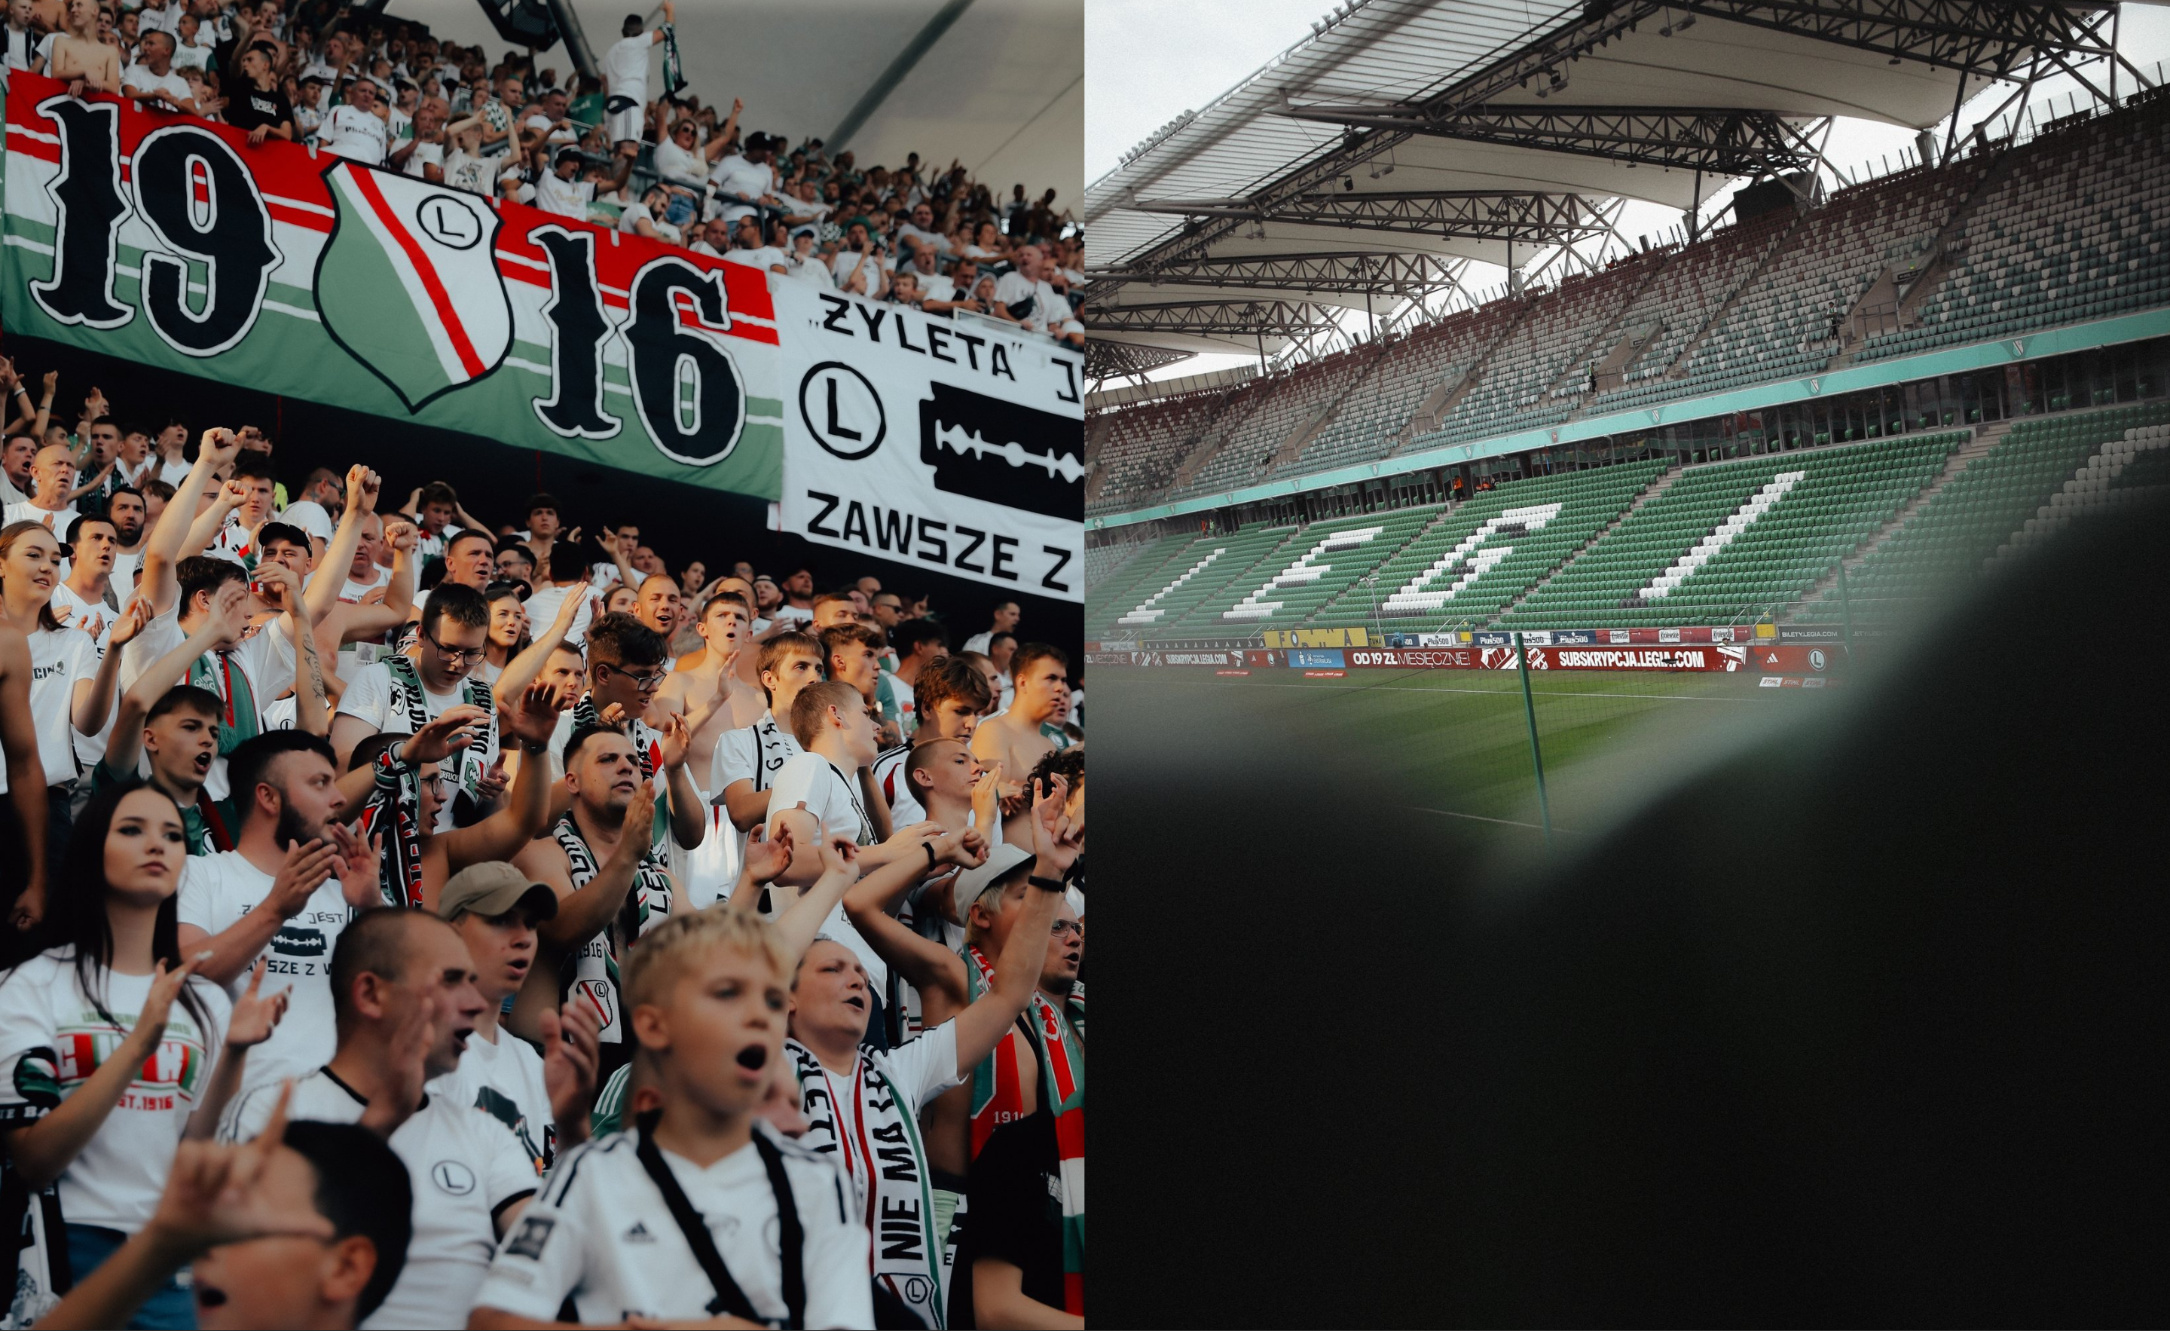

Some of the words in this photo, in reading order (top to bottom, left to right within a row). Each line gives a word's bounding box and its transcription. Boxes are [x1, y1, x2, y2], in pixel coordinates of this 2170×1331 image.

[436, 205, 466, 238] L
[29, 94, 284, 357] 19
[528, 224, 748, 467] 16
[1051, 357, 1084, 404] J
[826, 377, 863, 442] L
[807, 489, 1019, 581] ZAWSZE
[1041, 545, 1072, 593] Z
[1480, 636, 1504, 645] Plus500
[1559, 635, 1589, 644] Plus500
[1353, 652, 1370, 665] OD
[1371, 652, 1383, 665] 19
[1383, 652, 1398, 665] ZŁ
[306, 911, 344, 925] JEST
[577, 942, 603, 959] 1916
[305, 963, 315, 976] Z
[993, 1110, 1024, 1124] 191
[872, 1120, 919, 1183] MA
[880, 1195, 924, 1261] NIE
